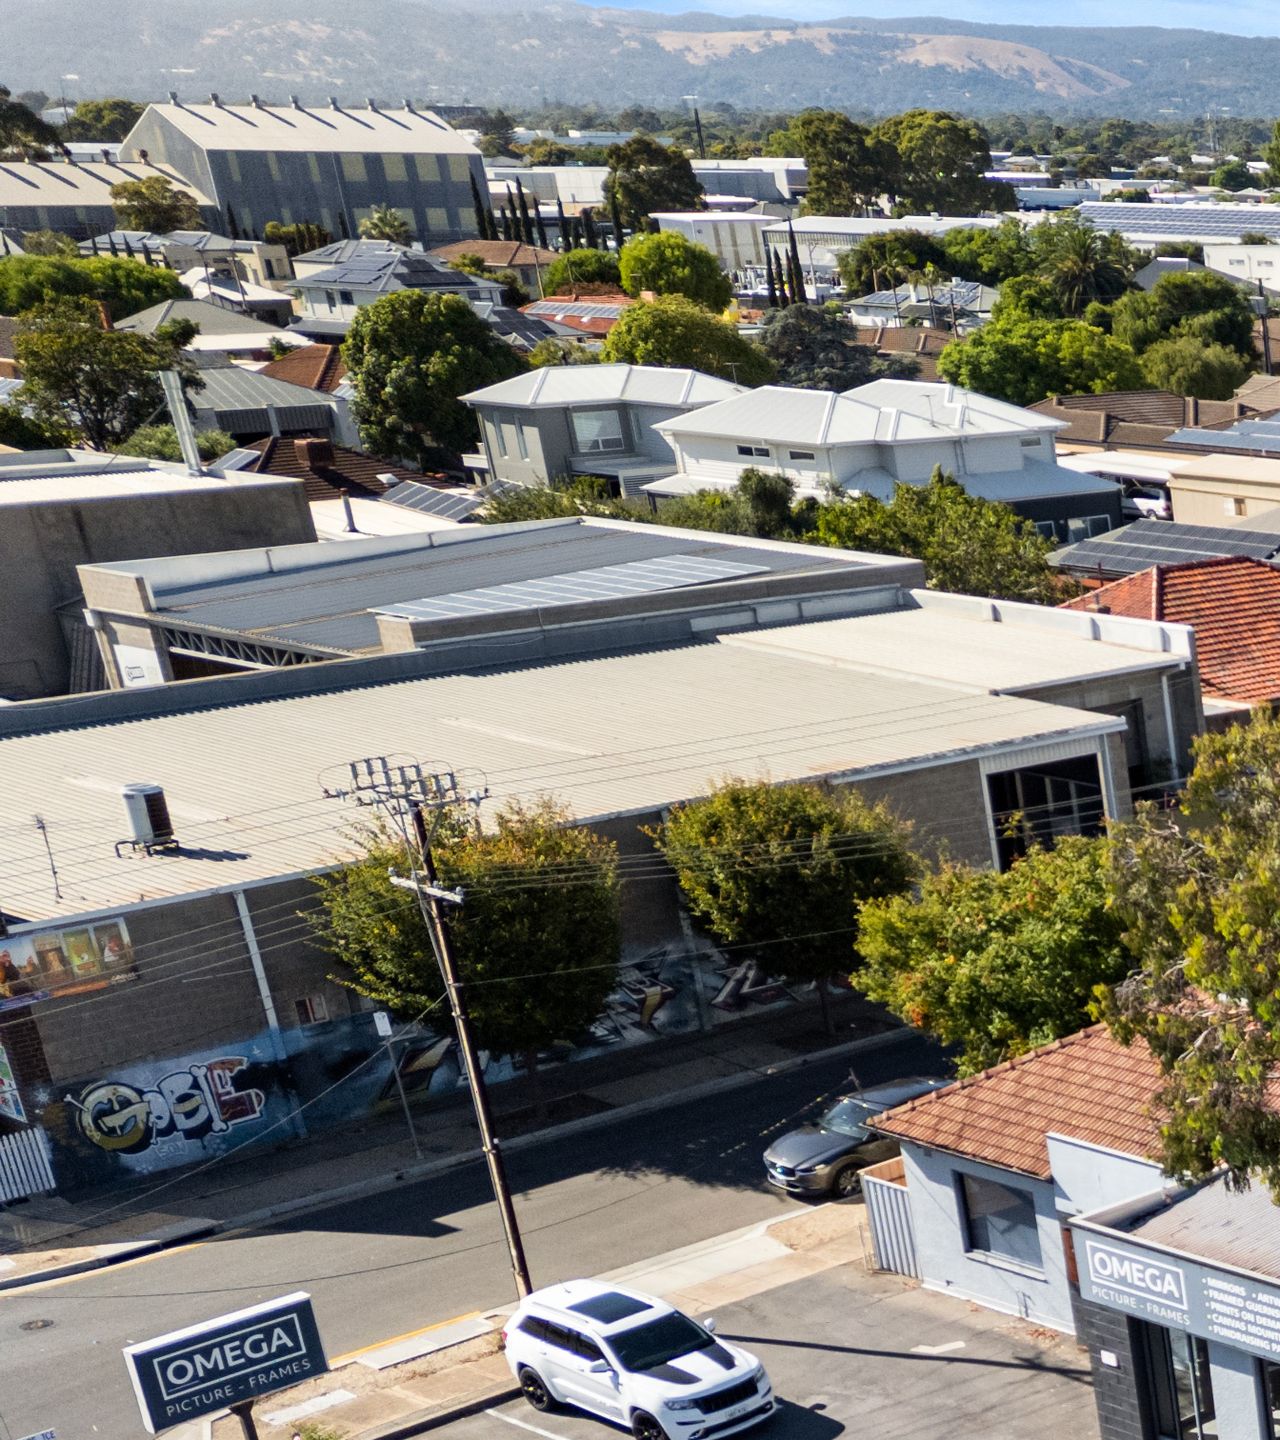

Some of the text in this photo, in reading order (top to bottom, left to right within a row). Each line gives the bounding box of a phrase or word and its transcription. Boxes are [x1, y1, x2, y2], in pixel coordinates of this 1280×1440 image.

[1093, 1252, 1181, 1299] OMEGA
[1207, 1277, 1247, 1296] MIRRORS
[1091, 1286, 1138, 1309] PICTURE
[1147, 1303, 1191, 1325] FRAMES
[1209, 1290, 1245, 1308] FRAMED
[1211, 1302, 1241, 1320] PRINTS
[1241, 1310, 1255, 1324] ON
[1212, 1313, 1247, 1332] CANVAS
[1213, 1326, 1271, 1351] FUNDRAISING
[167, 1327, 294, 1385] OMEGA
[166, 1384, 235, 1416] PICTURE
[249, 1358, 312, 1389] FRAMES
